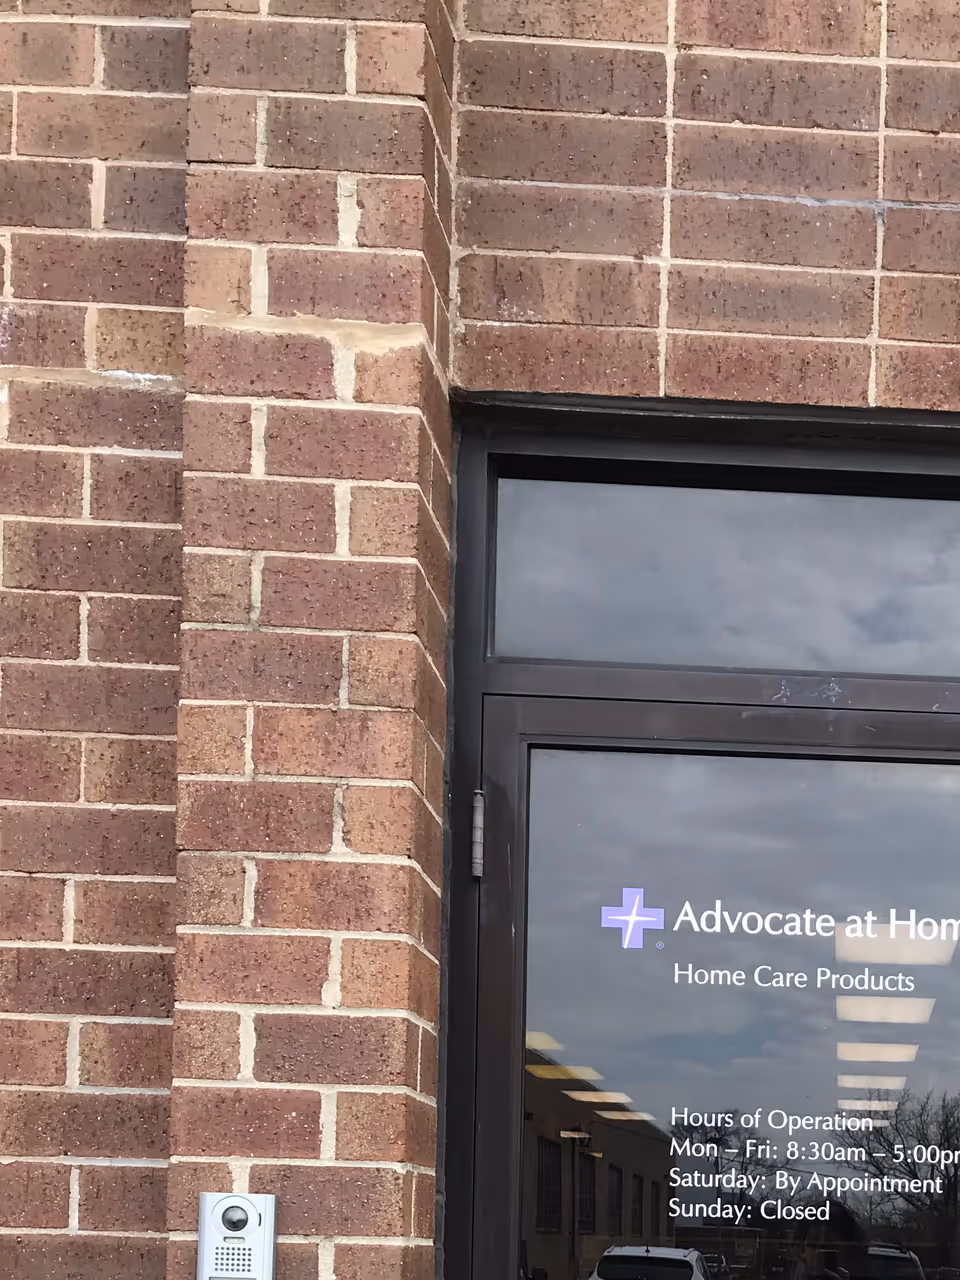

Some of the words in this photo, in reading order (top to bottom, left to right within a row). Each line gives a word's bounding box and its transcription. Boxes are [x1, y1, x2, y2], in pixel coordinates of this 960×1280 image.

[672, 900, 836, 937] Advocate
[845, 911, 878, 939] at
[674, 963, 746, 986] Home
[753, 965, 808, 988] Care
[816, 967, 915, 992] Products
[671, 1107, 734, 1128] Hours
[740, 1108, 762, 1128] of
[767, 1110, 874, 1136] Operation
[669, 1139, 718, 1157] Mon
[746, 1140, 778, 1159] Fri:
[786, 1141, 866, 1161] 8:30am
[669, 1168, 767, 1195] Saturday:
[775, 1170, 800, 1195] By
[806, 1171, 944, 1197] Appointment
[668, 1198, 752, 1225] Sunday:
[760, 1199, 830, 1221] Closed
